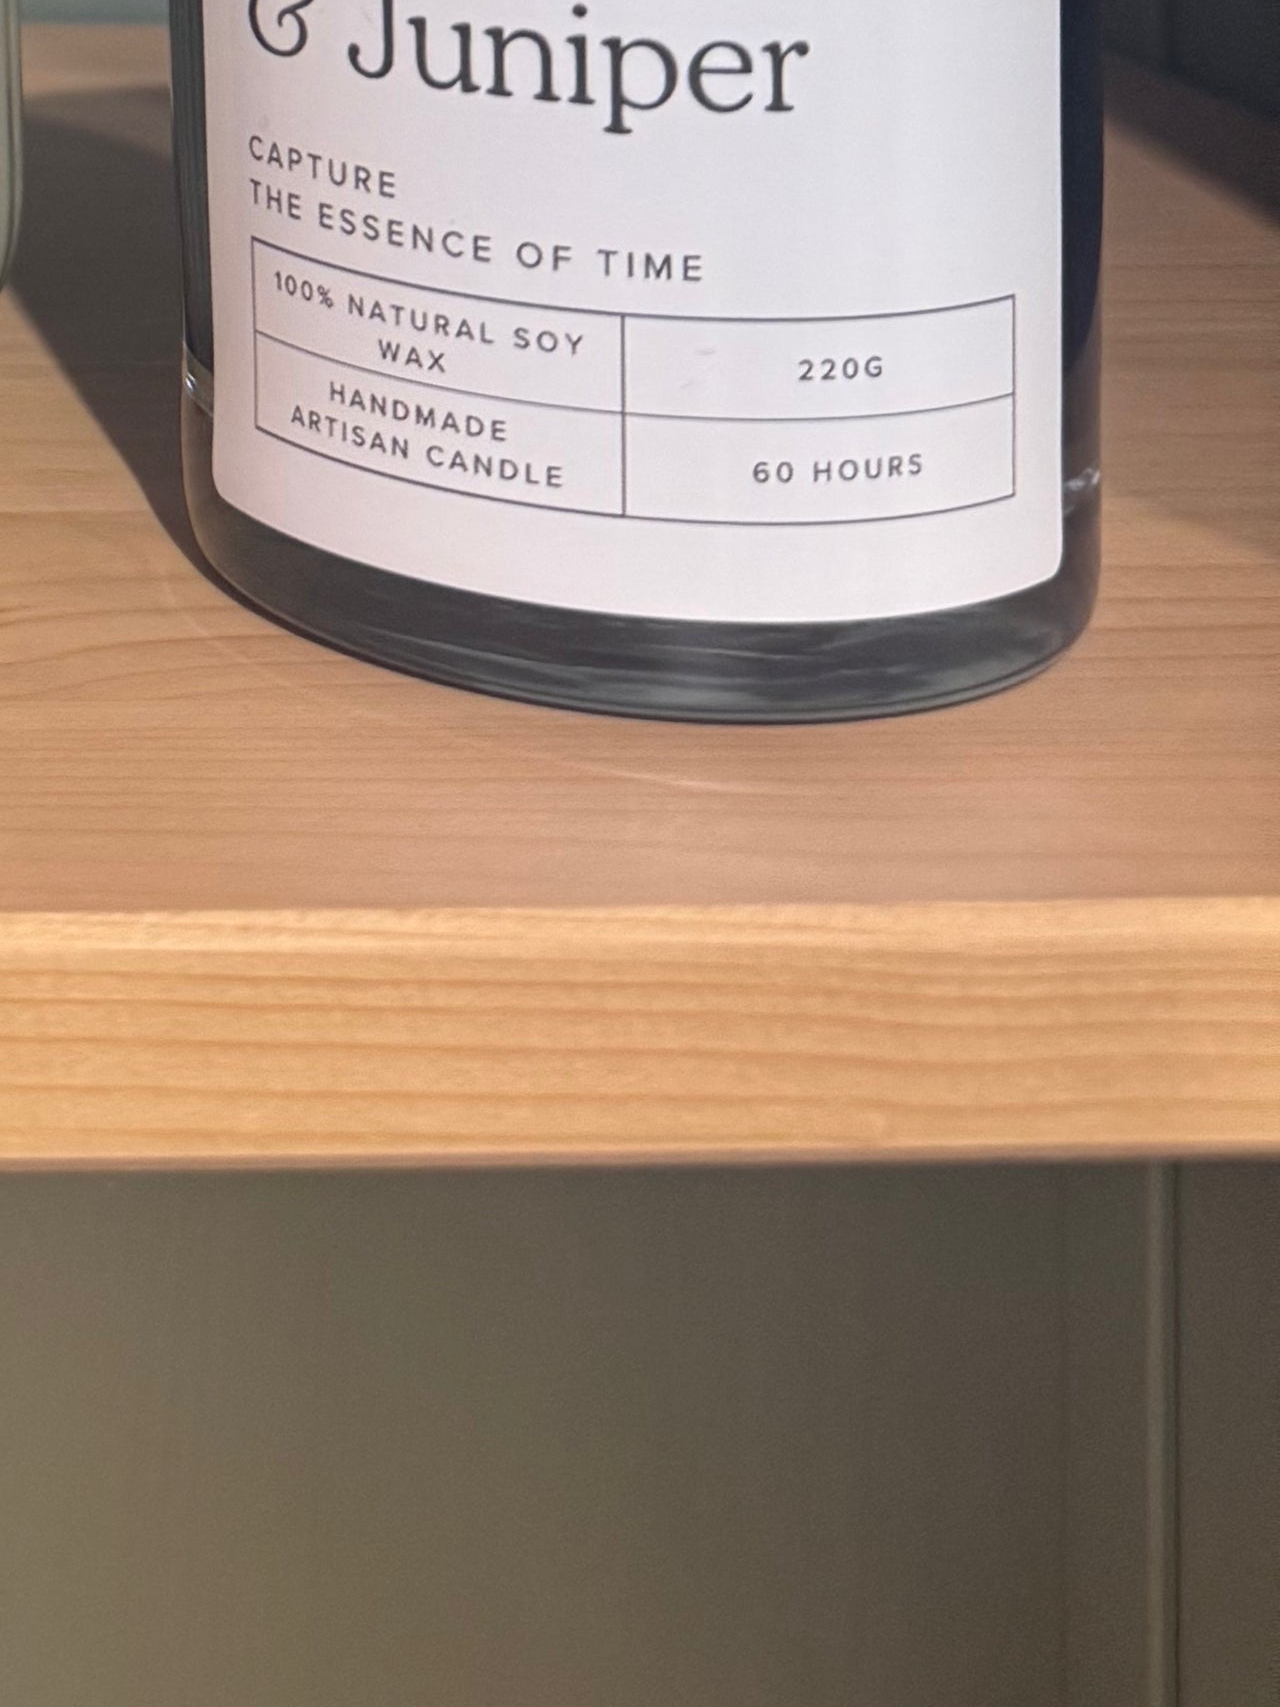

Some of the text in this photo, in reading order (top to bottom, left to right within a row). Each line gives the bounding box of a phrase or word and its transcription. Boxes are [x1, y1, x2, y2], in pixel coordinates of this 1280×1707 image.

[248, 133, 397, 201] CAPTURE
[248, 176, 704, 284] THE ESSENCE OF TIME
[273, 269, 585, 357] 100% NATURAL SOY
[376, 337, 447, 375] WAX
[796, 354, 884, 383] 220G
[328, 379, 508, 444] HANDMADE
[289, 403, 564, 490] ARTISAN CANDLE
[751, 451, 924, 486] 60 HOURS
